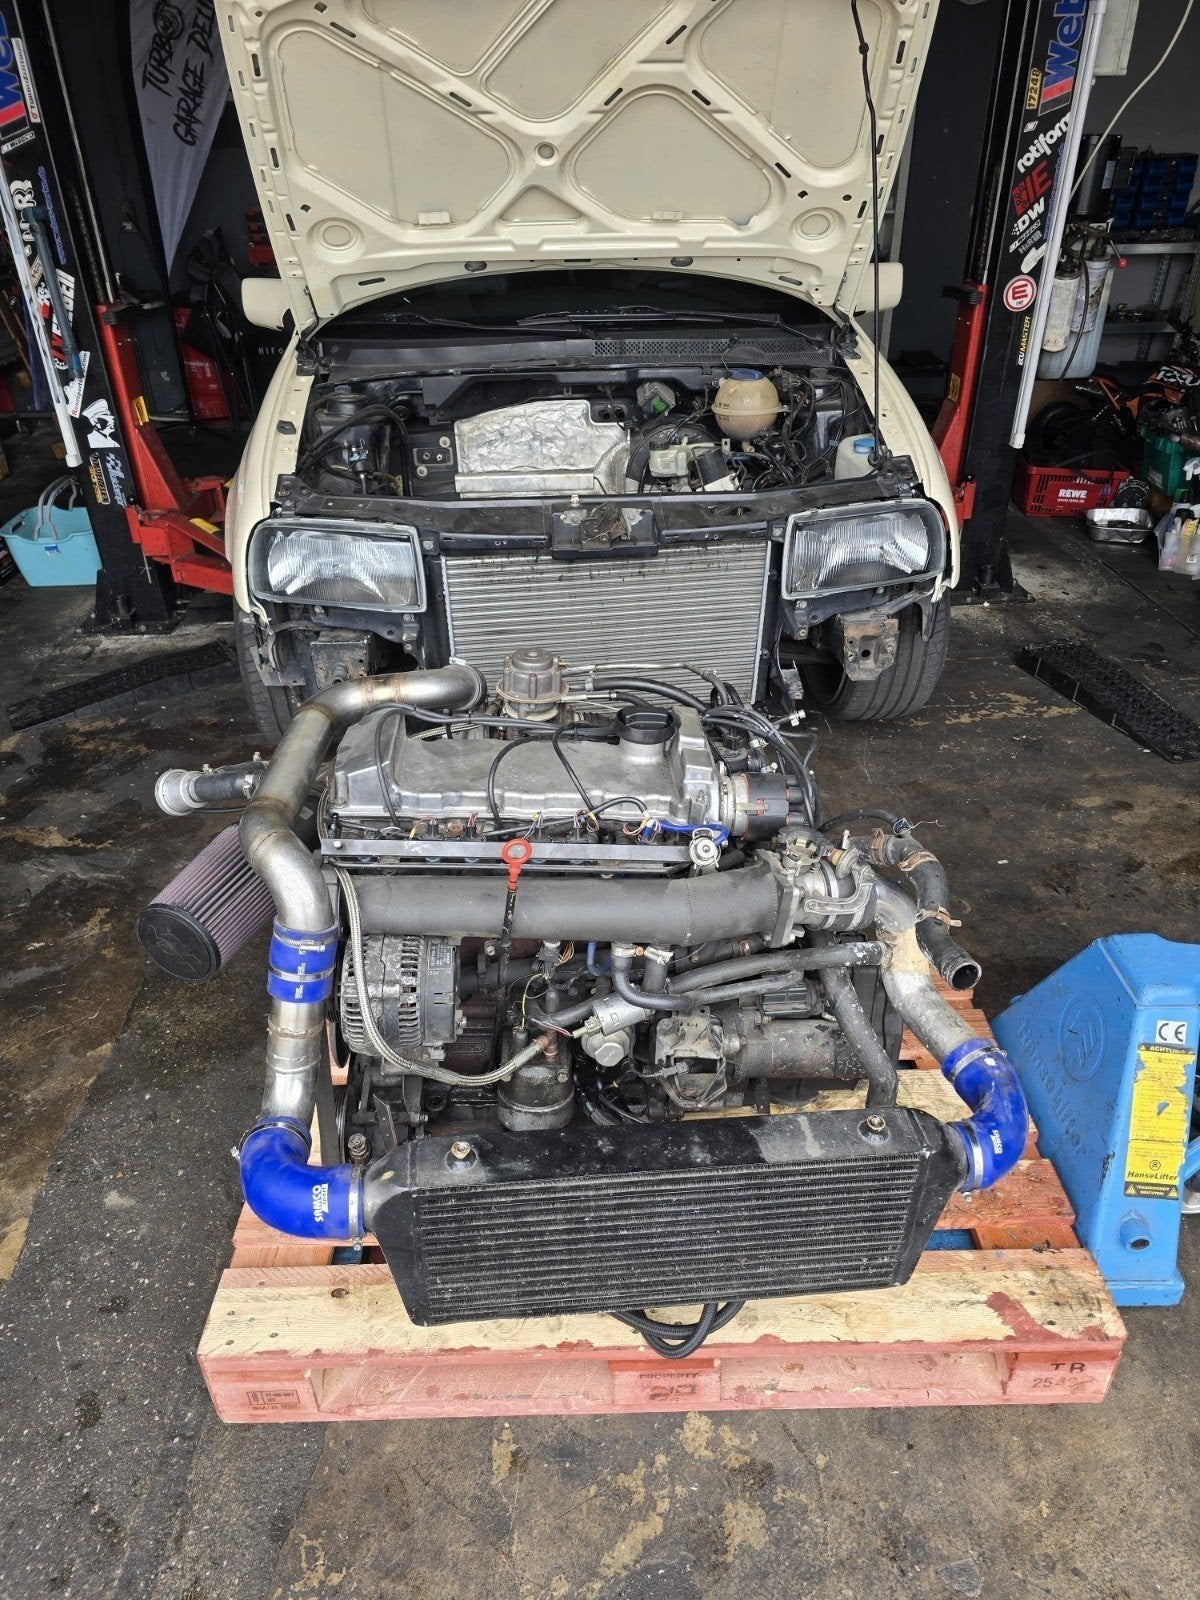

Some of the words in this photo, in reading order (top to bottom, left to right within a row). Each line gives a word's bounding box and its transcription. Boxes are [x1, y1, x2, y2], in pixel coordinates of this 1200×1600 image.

[173, 57, 205, 147] GARAGE
[1027, 69, 1041, 108] 17248
[1017, 197, 1045, 234] DW
[1058, 488, 1088, 499] REWE
[1158, 1022, 1186, 1043] CE
[1127, 1170, 1179, 1182] HanseLifter
[310, 1184, 322, 1223] SAMCO
